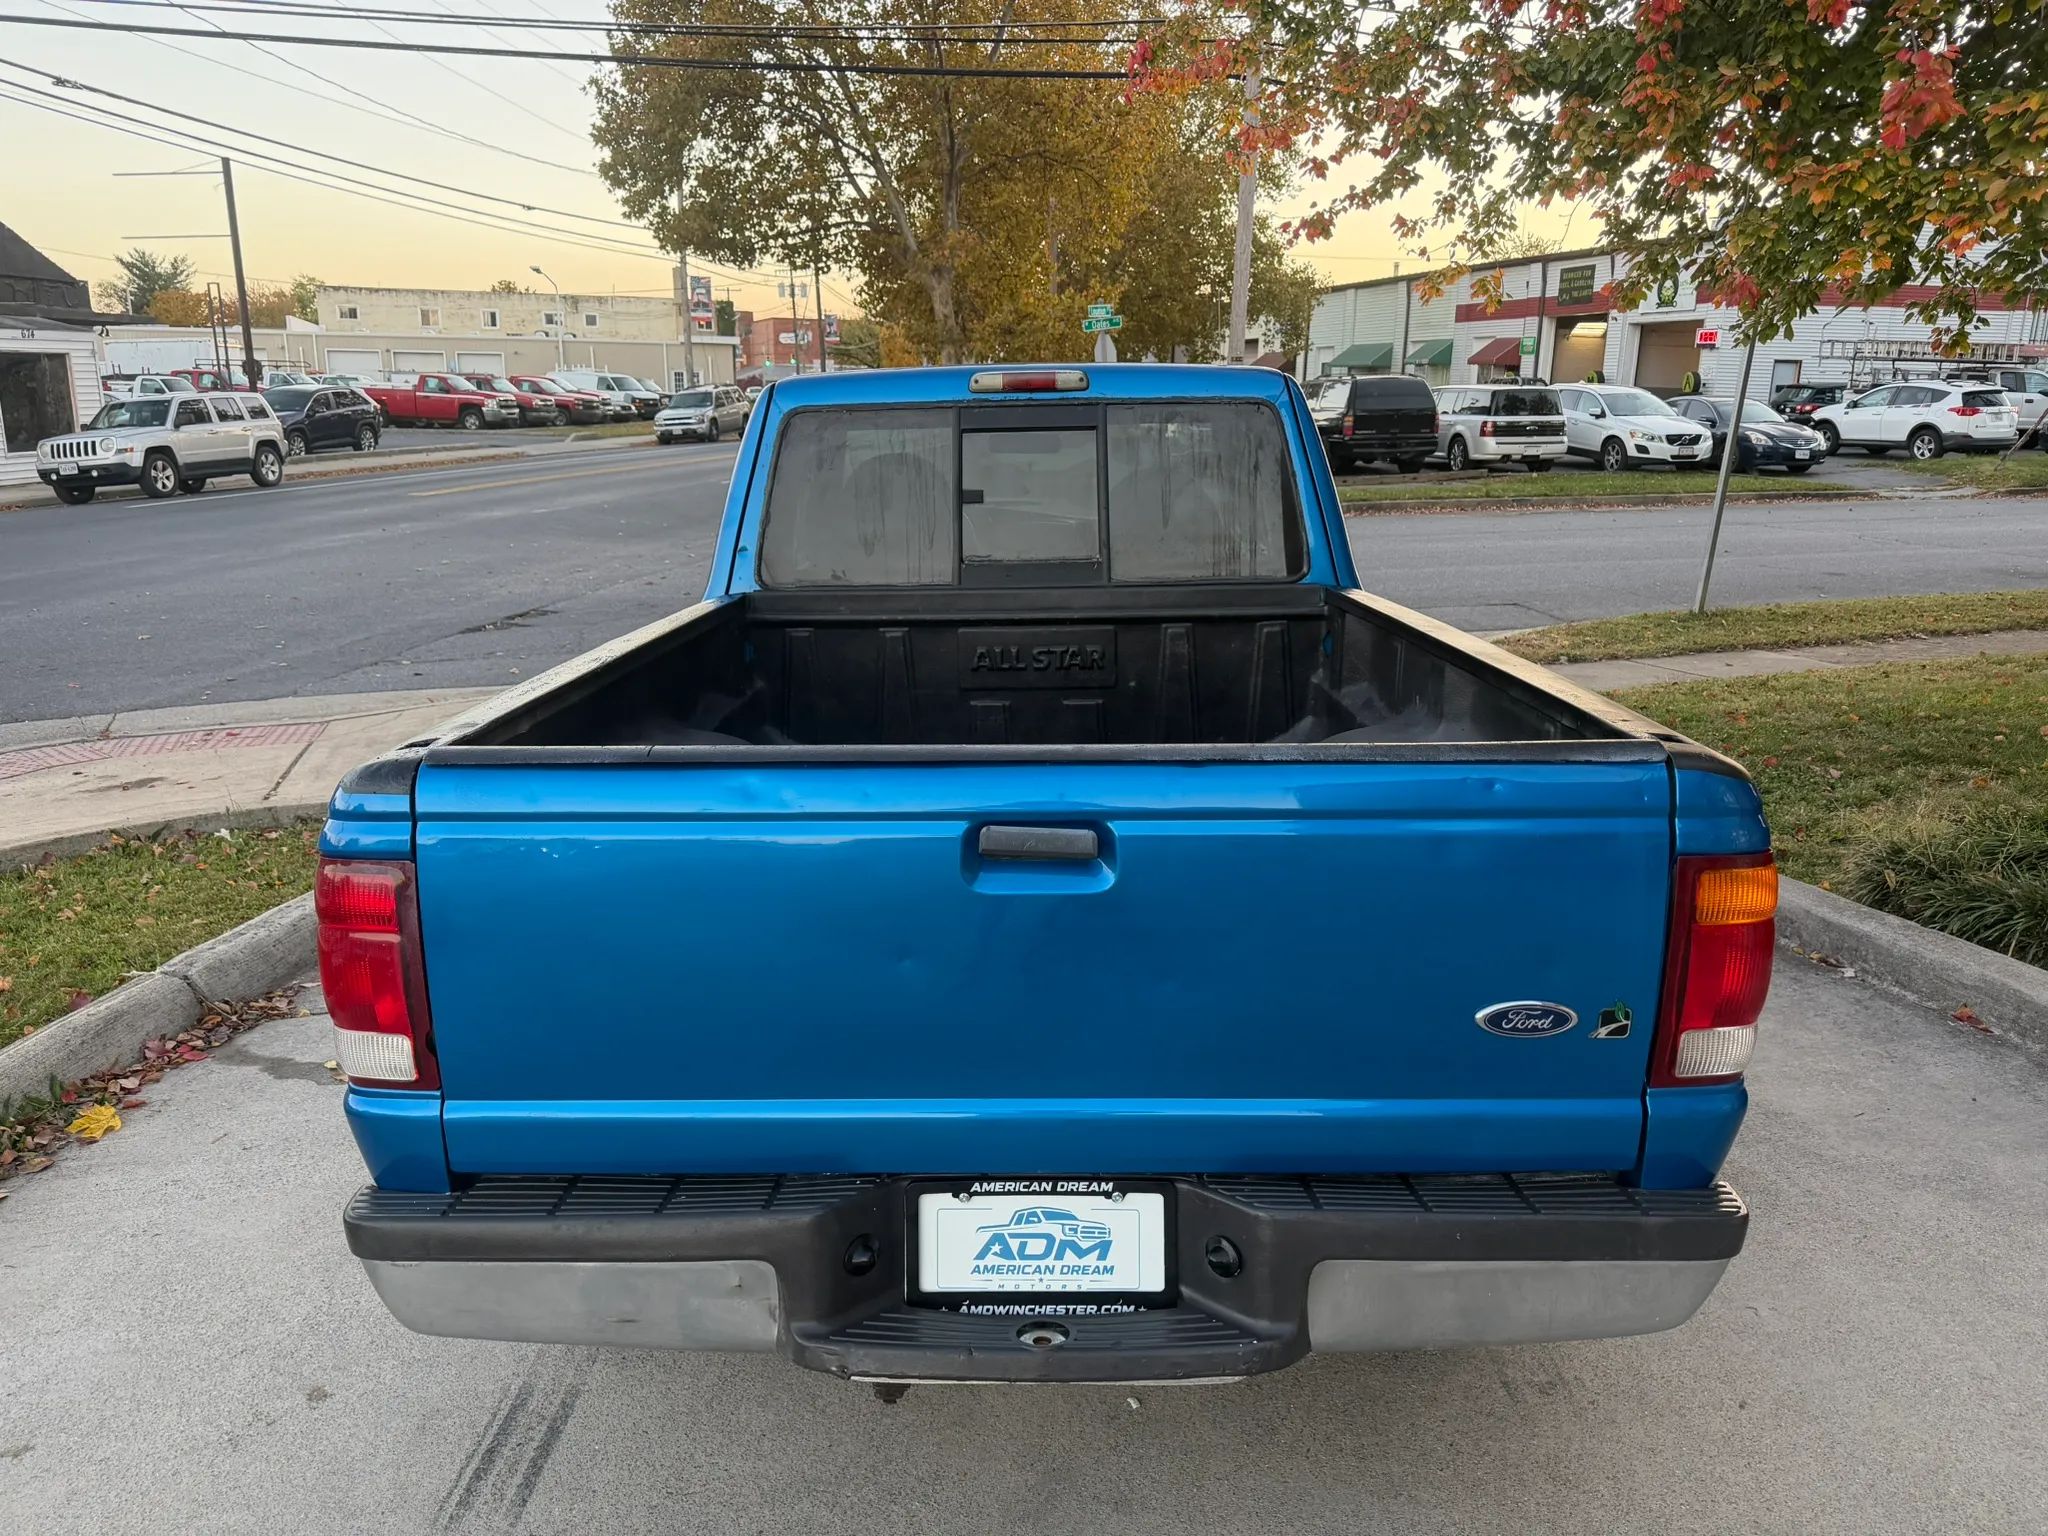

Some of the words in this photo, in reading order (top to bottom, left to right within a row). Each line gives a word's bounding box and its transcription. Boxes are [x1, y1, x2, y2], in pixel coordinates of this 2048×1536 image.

[971, 646, 1027, 672] ALL
[1032, 645, 1105, 671] STAR
[1502, 1010, 1554, 1029] Ford
[970, 1181, 1053, 1193] AMERICAN
[1056, 1181, 1114, 1192] DREAM
[973, 1232, 1113, 1261] ADM
[970, 1264, 1056, 1276] AMERICAN
[1059, 1264, 1115, 1276] DREAM
